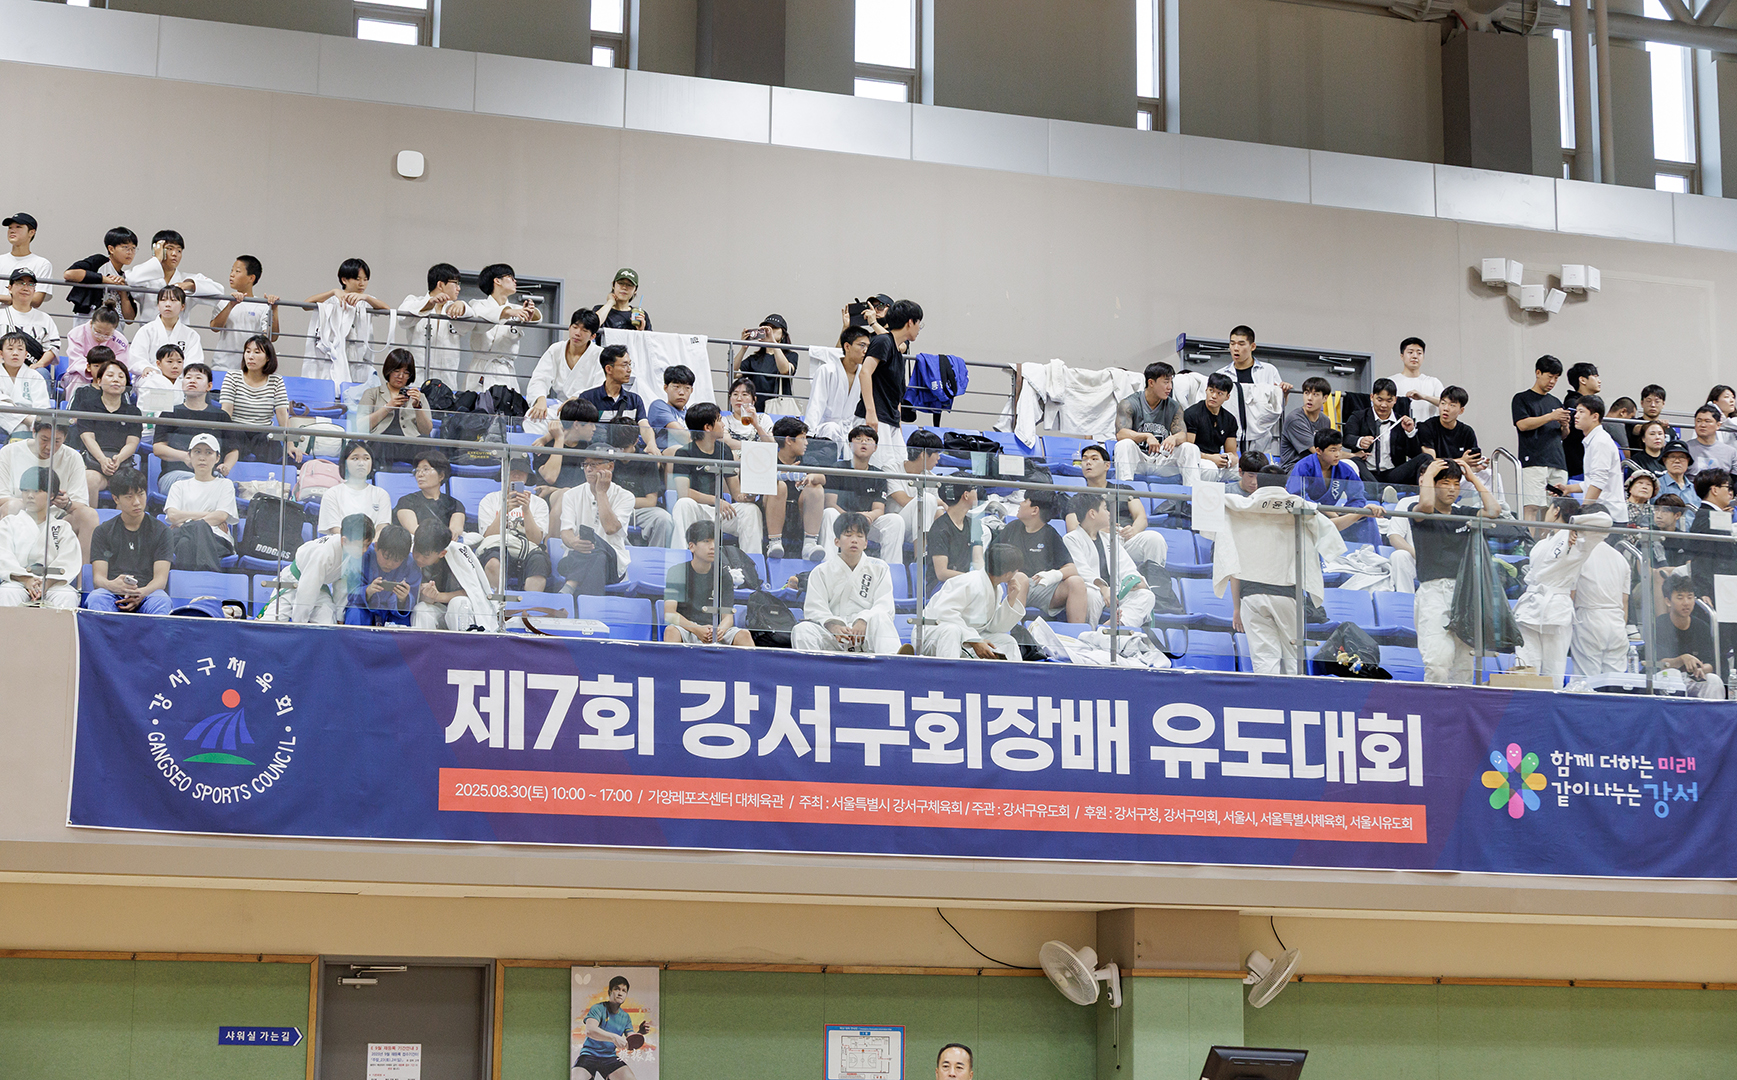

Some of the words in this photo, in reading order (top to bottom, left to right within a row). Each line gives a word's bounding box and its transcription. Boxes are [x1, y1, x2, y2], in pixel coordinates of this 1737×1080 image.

[1331, 480, 1340, 500] SKY
[859, 574, 872, 599] GURO
[148, 656, 294, 717] 강서구체육회
[444, 668, 656, 756] 제7회
[679, 679, 1131, 775] 강서구회장배
[1149, 702, 1425, 787] 유도대회
[147, 731, 193, 792] GANGSEO
[192, 782, 252, 804] SPORTS
[251, 736, 297, 793] COUNCIL
[1550, 750, 1594, 778] 함께
[1600, 754, 1655, 779] 더하는
[1657, 756, 1696, 774] 미래
[455, 781, 548, 800] 2025.08.30(토)
[552, 786, 586, 801] 10:00
[600, 787, 633, 802] 17:00
[647, 788, 732, 806] 가양레포츠센터
[735, 791, 784, 809] 대체육관
[799, 795, 823, 811] 주최
[831, 795, 889, 814] 서울특별시
[893, 798, 963, 817] 강서구체육회
[972, 801, 996, 817] 주관
[1003, 802, 1070, 820] 강서구유도회
[1084, 804, 1107, 821] 후원
[1115, 806, 1163, 824] 강서구청,
[1163, 808, 1222, 826] 강서구의회,
[1223, 810, 1260, 828] 서울시,
[1260, 812, 1349, 830] 서울특별시체육회,
[1350, 815, 1413, 832] 서울시유도회
[1551, 781, 1590, 807] 같이
[1594, 783, 1643, 807] 나누는
[1643, 781, 1699, 819] 강서
[225, 1030, 256, 1042] 샤워실
[259, 1031, 290, 1042] 가는길
